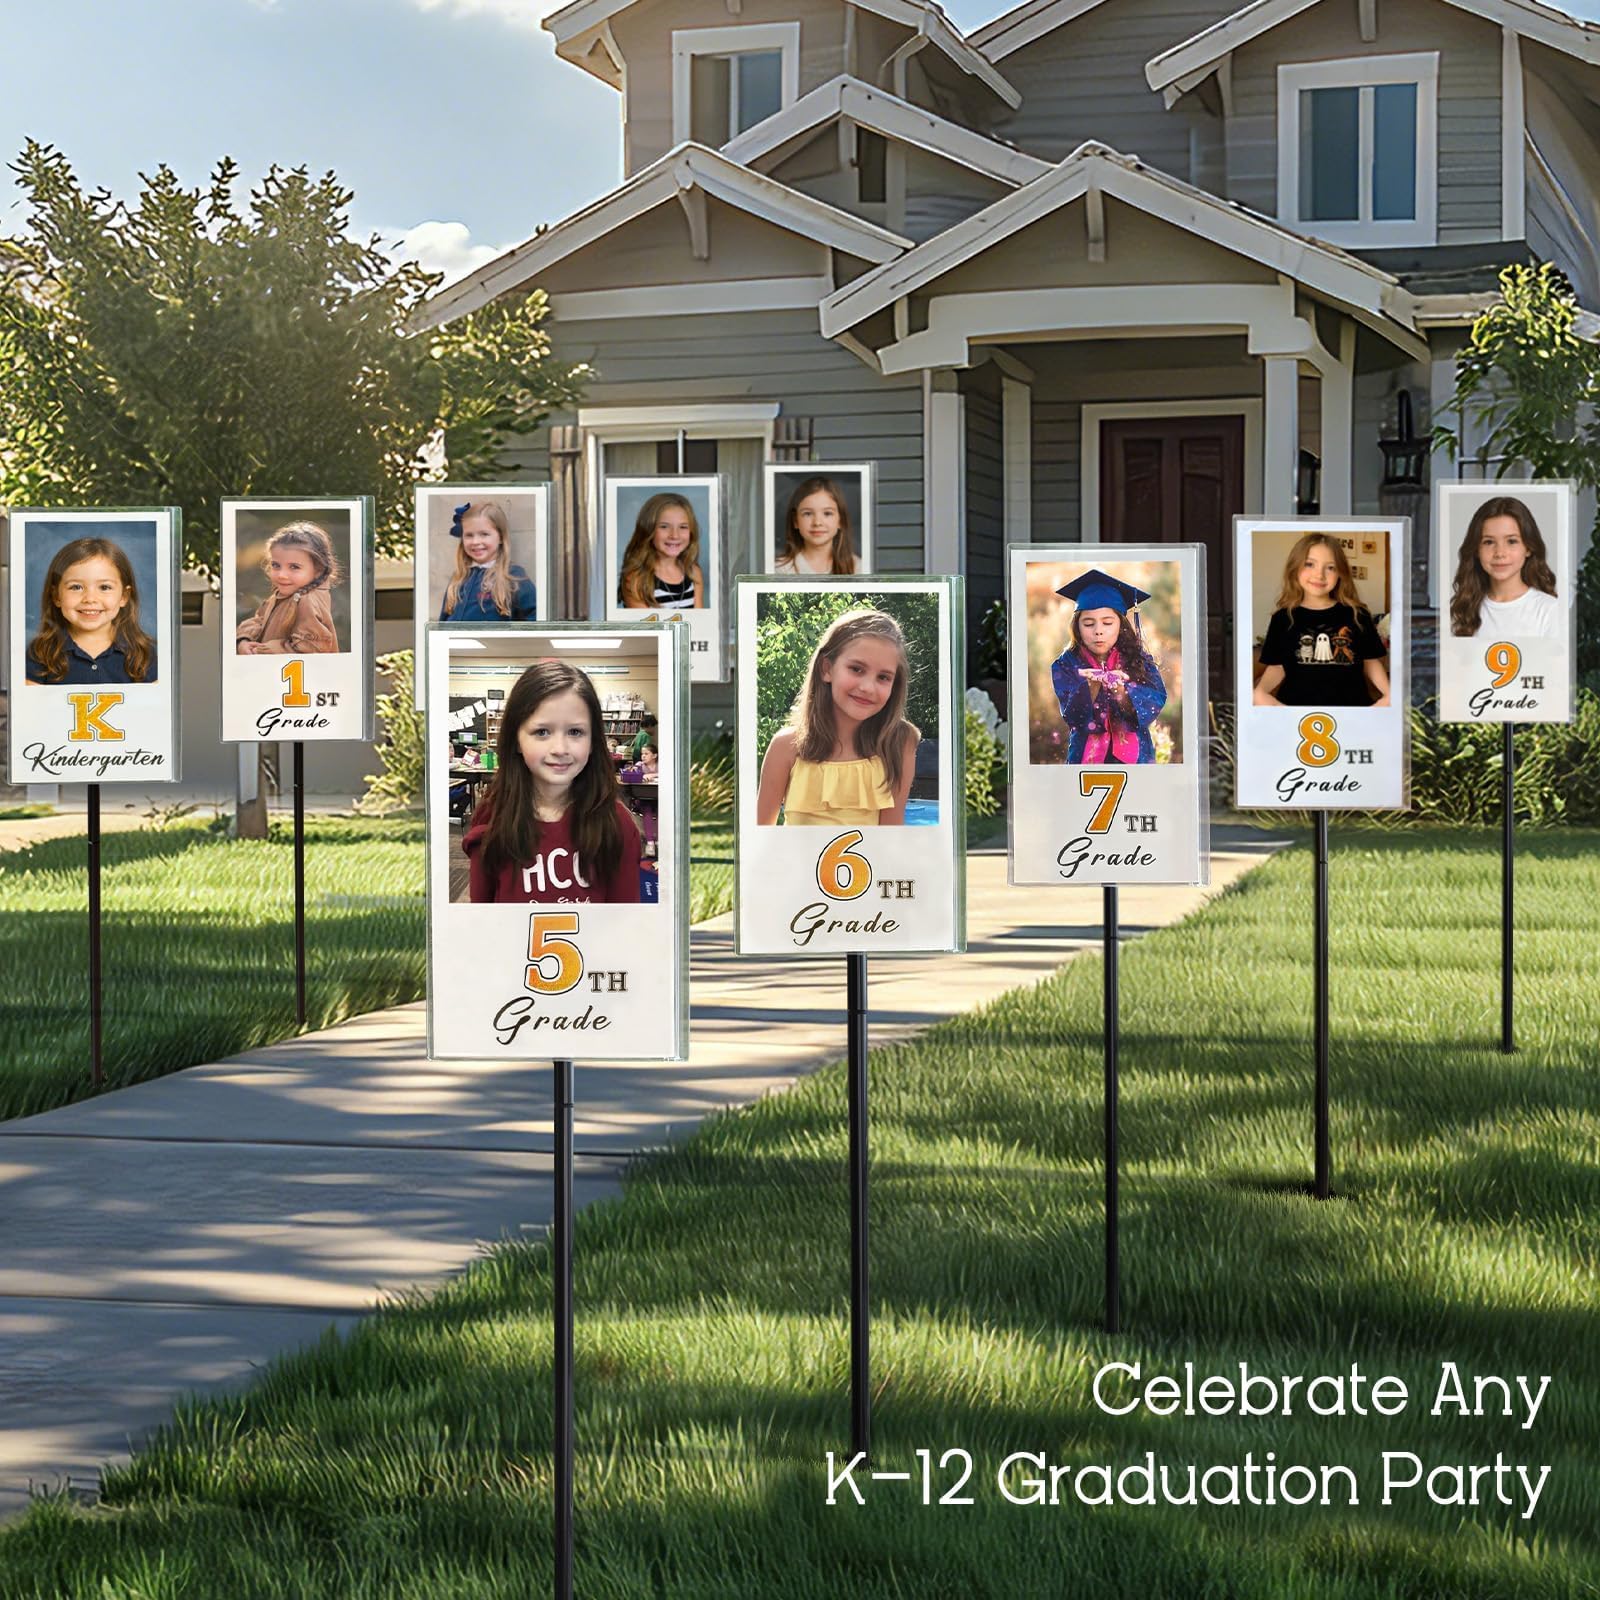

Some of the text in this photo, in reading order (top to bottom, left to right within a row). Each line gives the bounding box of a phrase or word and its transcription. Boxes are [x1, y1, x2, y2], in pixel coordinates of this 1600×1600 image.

[67, 692, 126, 742] K
[255, 707, 331, 737] Grade
[1468, 688, 1539, 718] Grade
[22, 743, 165, 777] Kindergarten
[1275, 768, 1362, 802] Grade
[1056, 836, 1157, 879] Grade
[789, 902, 901, 946] Grade
[492, 996, 612, 1046] Grade
